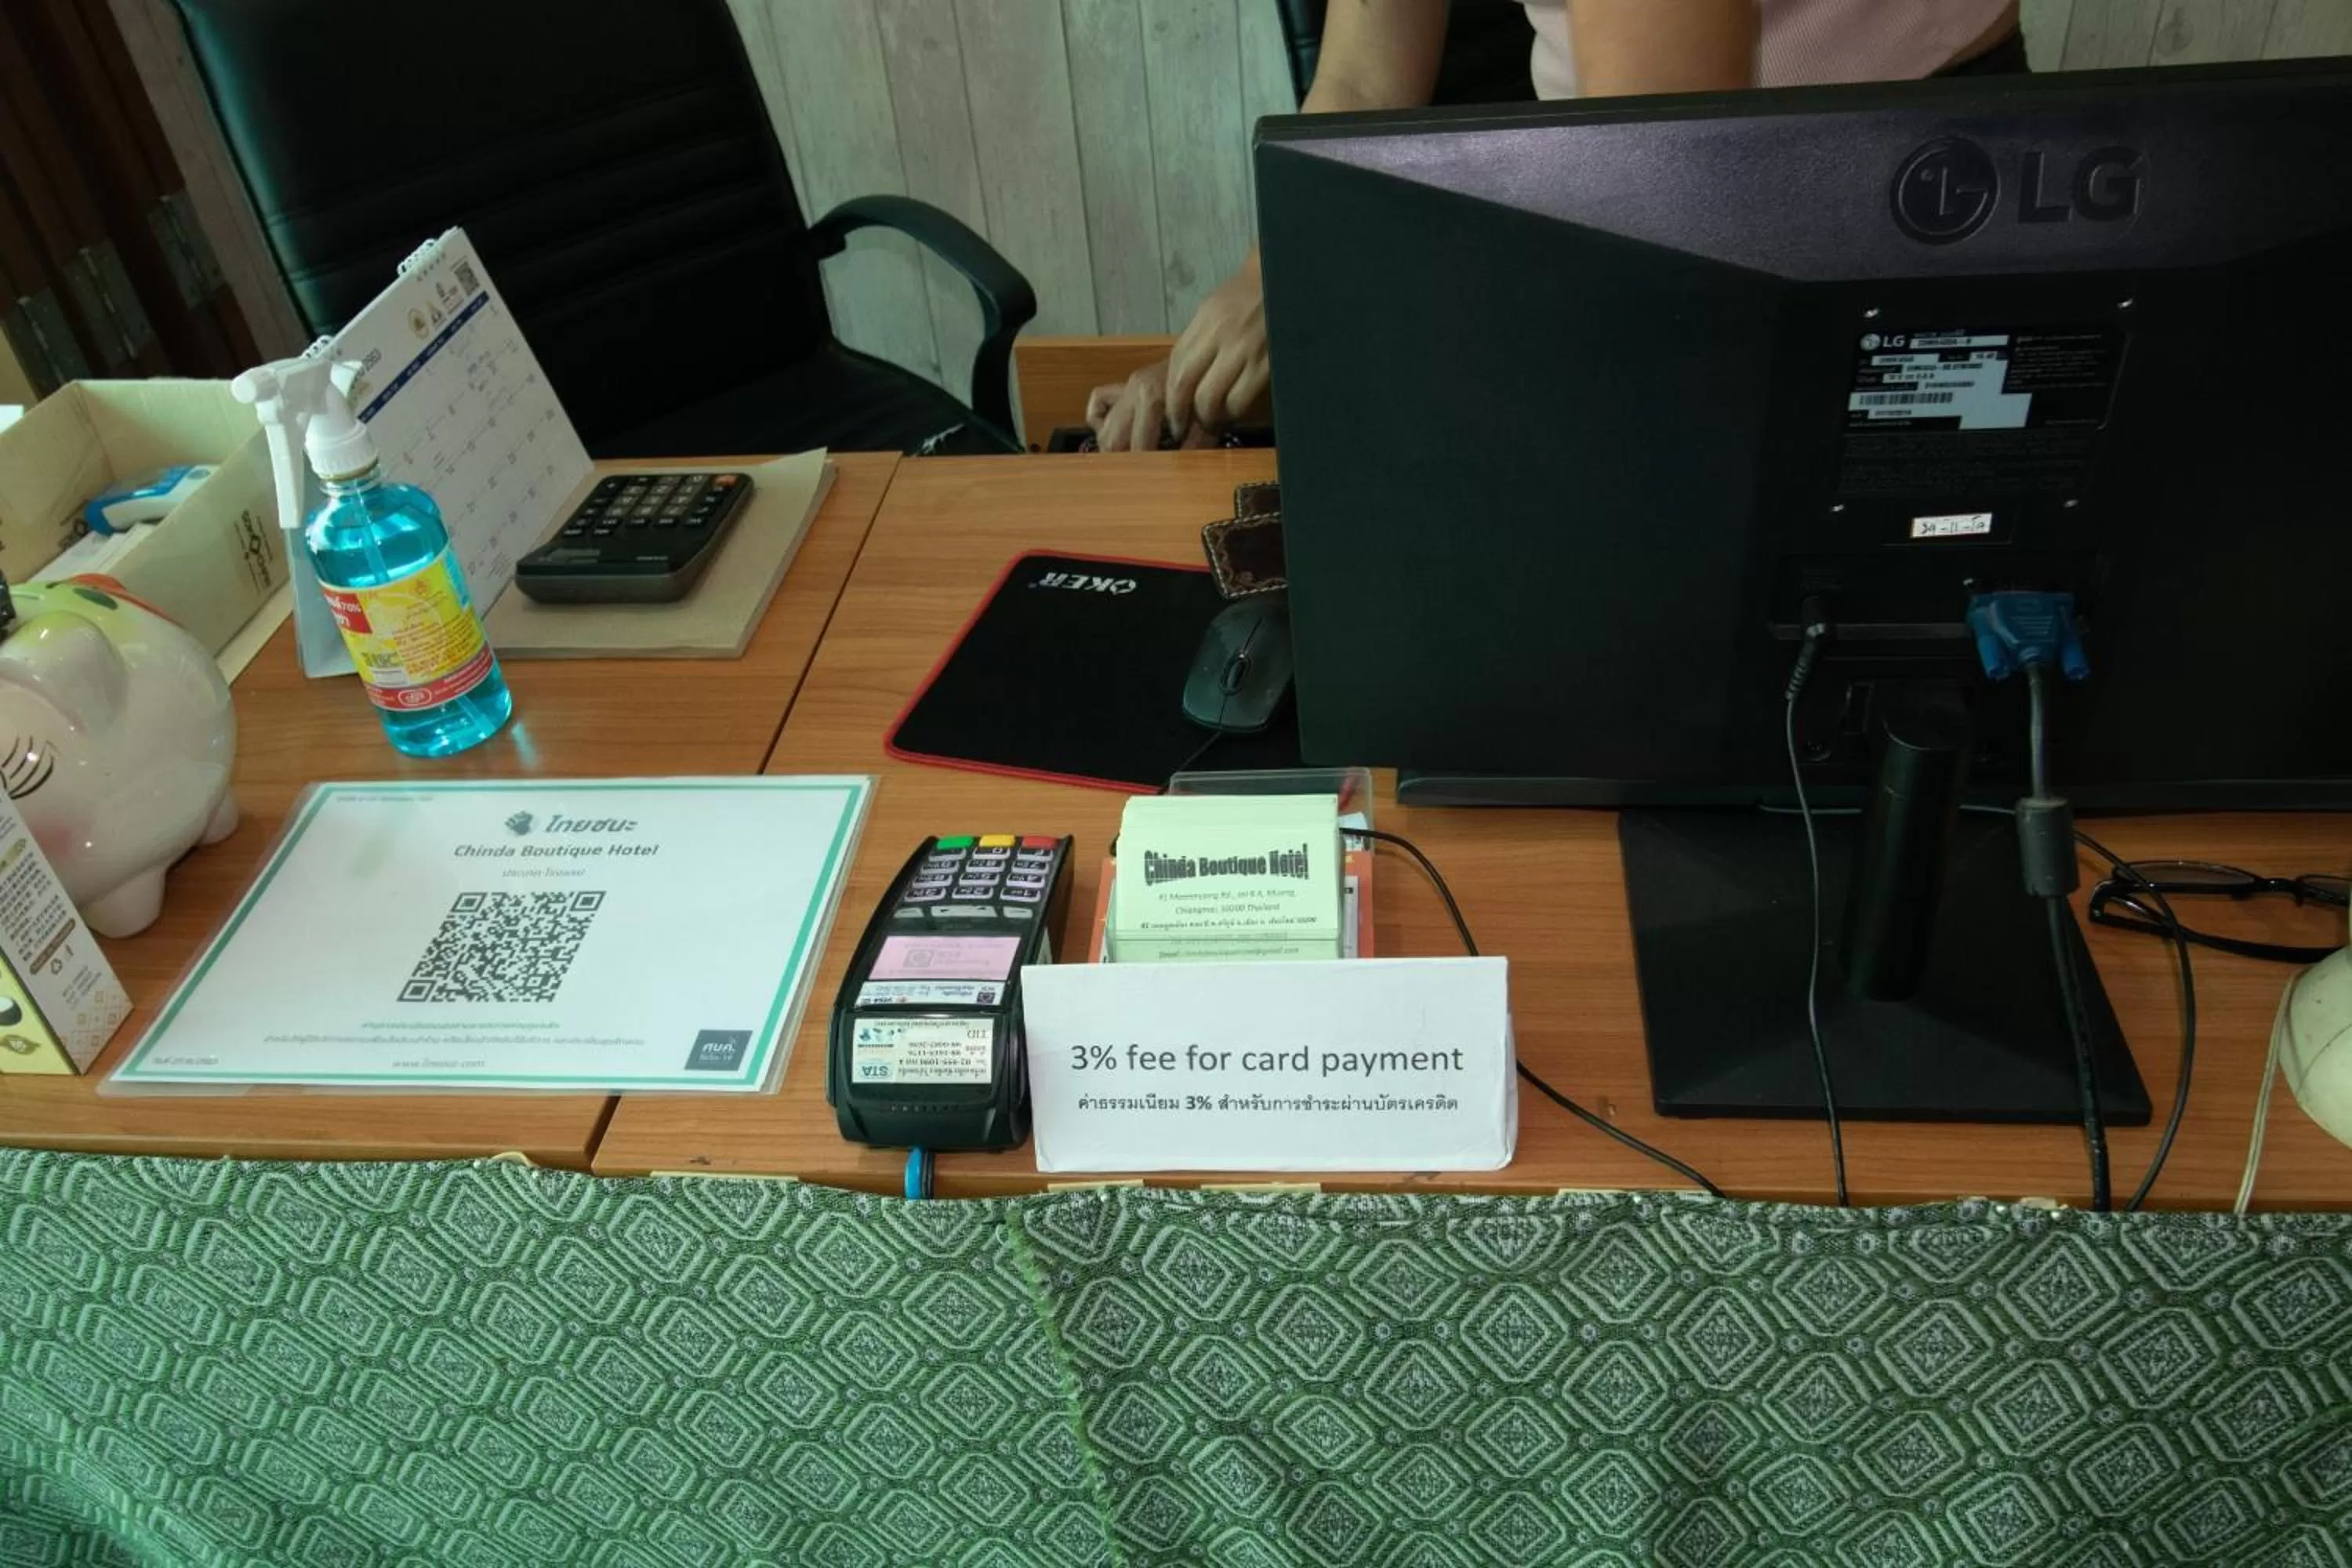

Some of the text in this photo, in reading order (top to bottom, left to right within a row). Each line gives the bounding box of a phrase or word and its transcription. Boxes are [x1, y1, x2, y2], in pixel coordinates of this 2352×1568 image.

[2018, 146, 2147, 223] LG
[1882, 335, 1906, 348] LG
[1039, 572, 1136, 595] OKER
[454, 843, 659, 858] Chinda Boutique Hotel
[1144, 842, 1310, 887] Chinda Boutique Hotel
[1070, 1044, 1465, 1077] 3% fee for card payment
[862, 1065, 889, 1077] STA
[1078, 1093, 1180, 1110] ค่าธรรมเนียม
[1185, 1095, 1212, 1110] 3%
